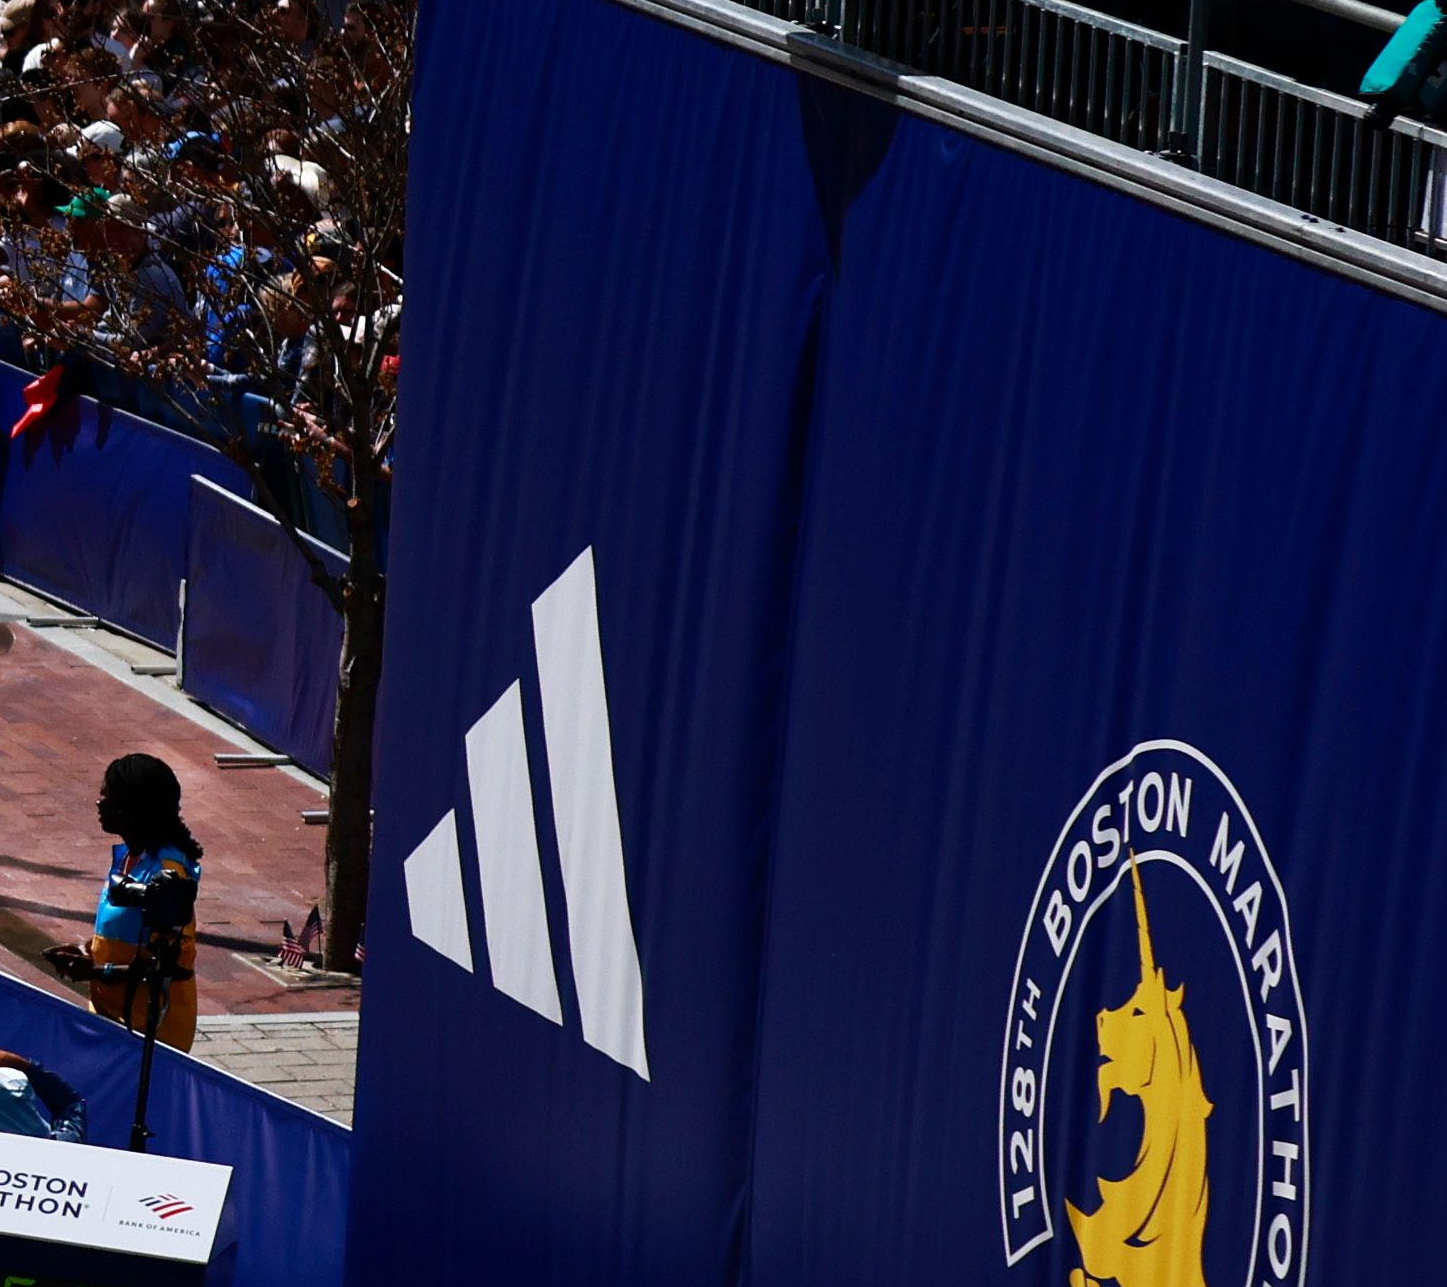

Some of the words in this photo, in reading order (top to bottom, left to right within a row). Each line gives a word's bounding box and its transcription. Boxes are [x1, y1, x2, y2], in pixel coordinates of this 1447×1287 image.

[1007, 979, 1042, 1221] 128TH
[1041, 774, 1193, 957] BOSTON
[118, 1219, 145, 1228] BANK
[160, 1225, 201, 1237] AMERICA
